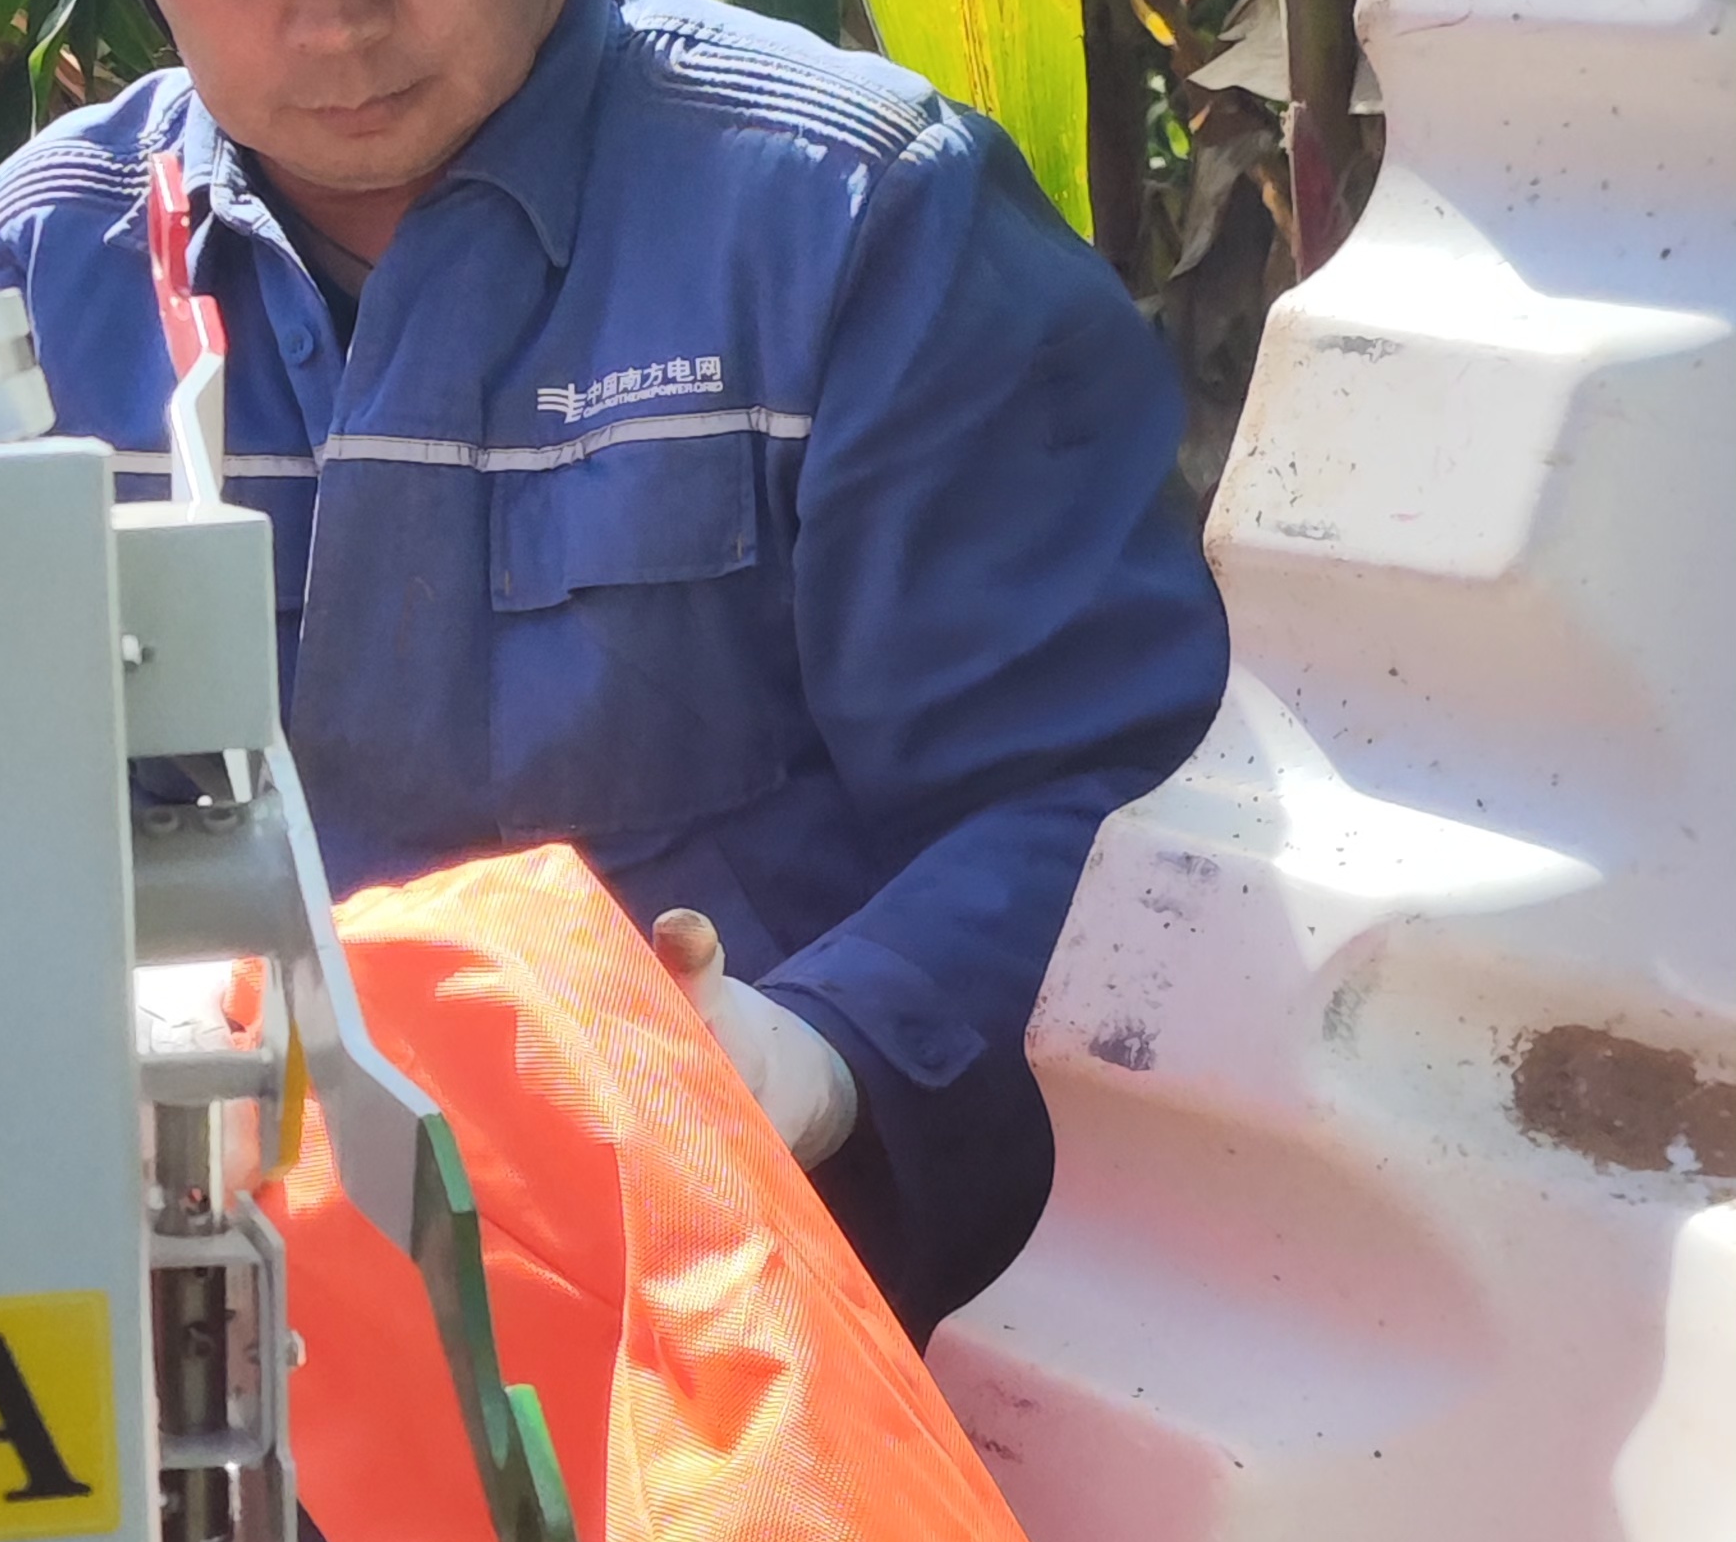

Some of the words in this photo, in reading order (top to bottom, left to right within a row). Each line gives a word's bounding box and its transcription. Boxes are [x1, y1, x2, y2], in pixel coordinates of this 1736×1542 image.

[586, 356, 721, 405] 中国南方电网
